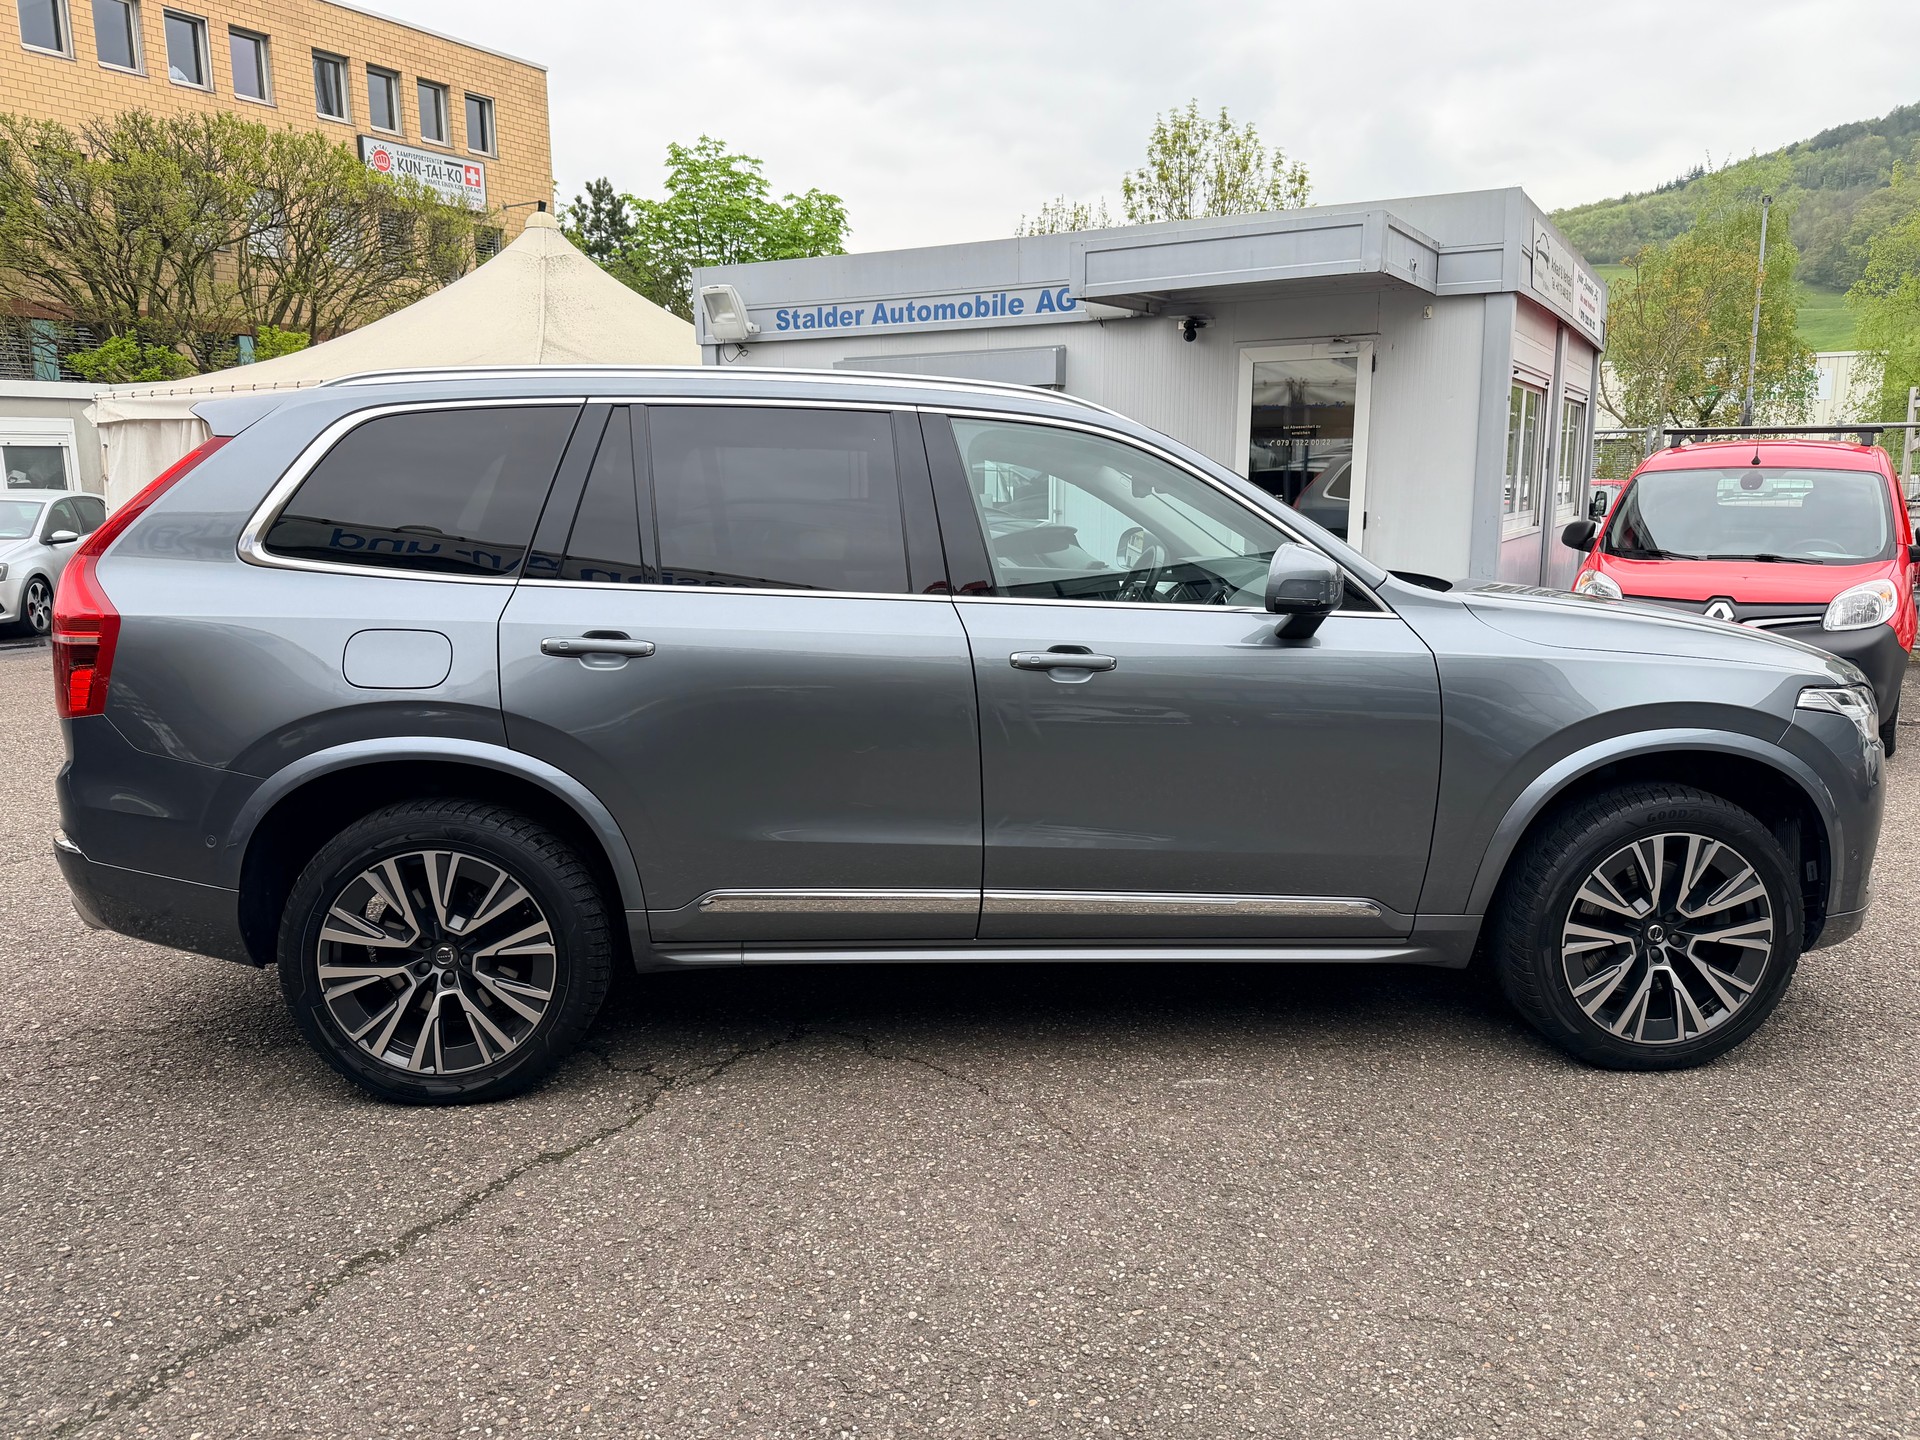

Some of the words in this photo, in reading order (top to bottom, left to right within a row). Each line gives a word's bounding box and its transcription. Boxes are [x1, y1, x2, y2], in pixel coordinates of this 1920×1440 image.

[397, 158, 462, 183] KUN-TAI-KO
[776, 308, 864, 331] Stalder
[871, 293, 1024, 325] Automobile
[1035, 288, 1077, 313] AG
[1276, 439, 1290, 447] 079
